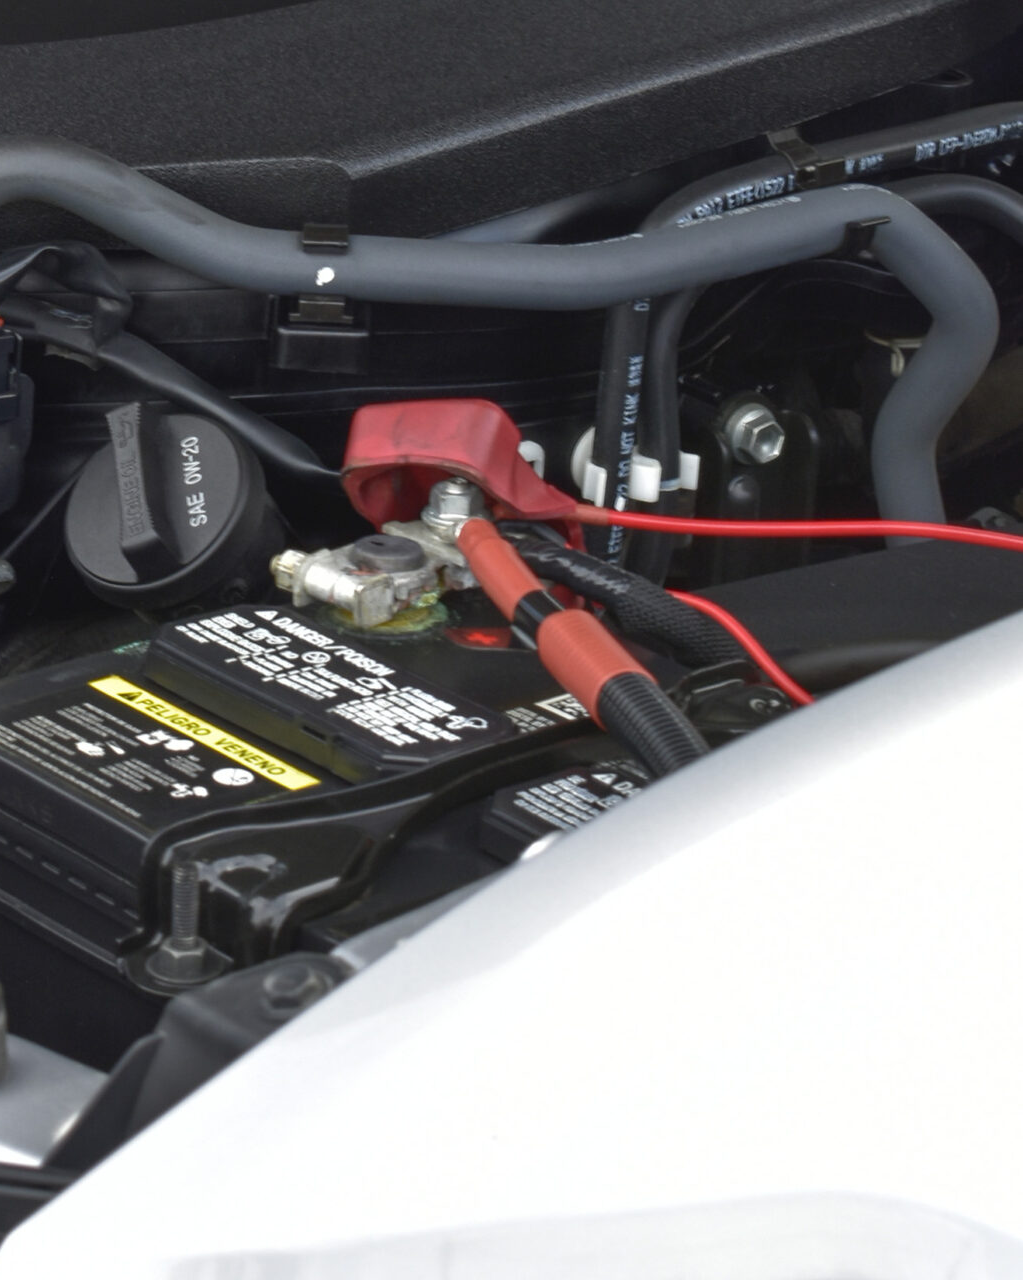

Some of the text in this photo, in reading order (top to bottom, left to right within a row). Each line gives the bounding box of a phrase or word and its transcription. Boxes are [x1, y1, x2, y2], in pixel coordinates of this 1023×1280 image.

[622, 392, 641, 425] KINK
[620, 431, 636, 455] NOT
[180, 436, 208, 528] SAE 0W-20
[136, 698, 212, 736] PELIGRO
[214, 737, 287, 776] VENENO
